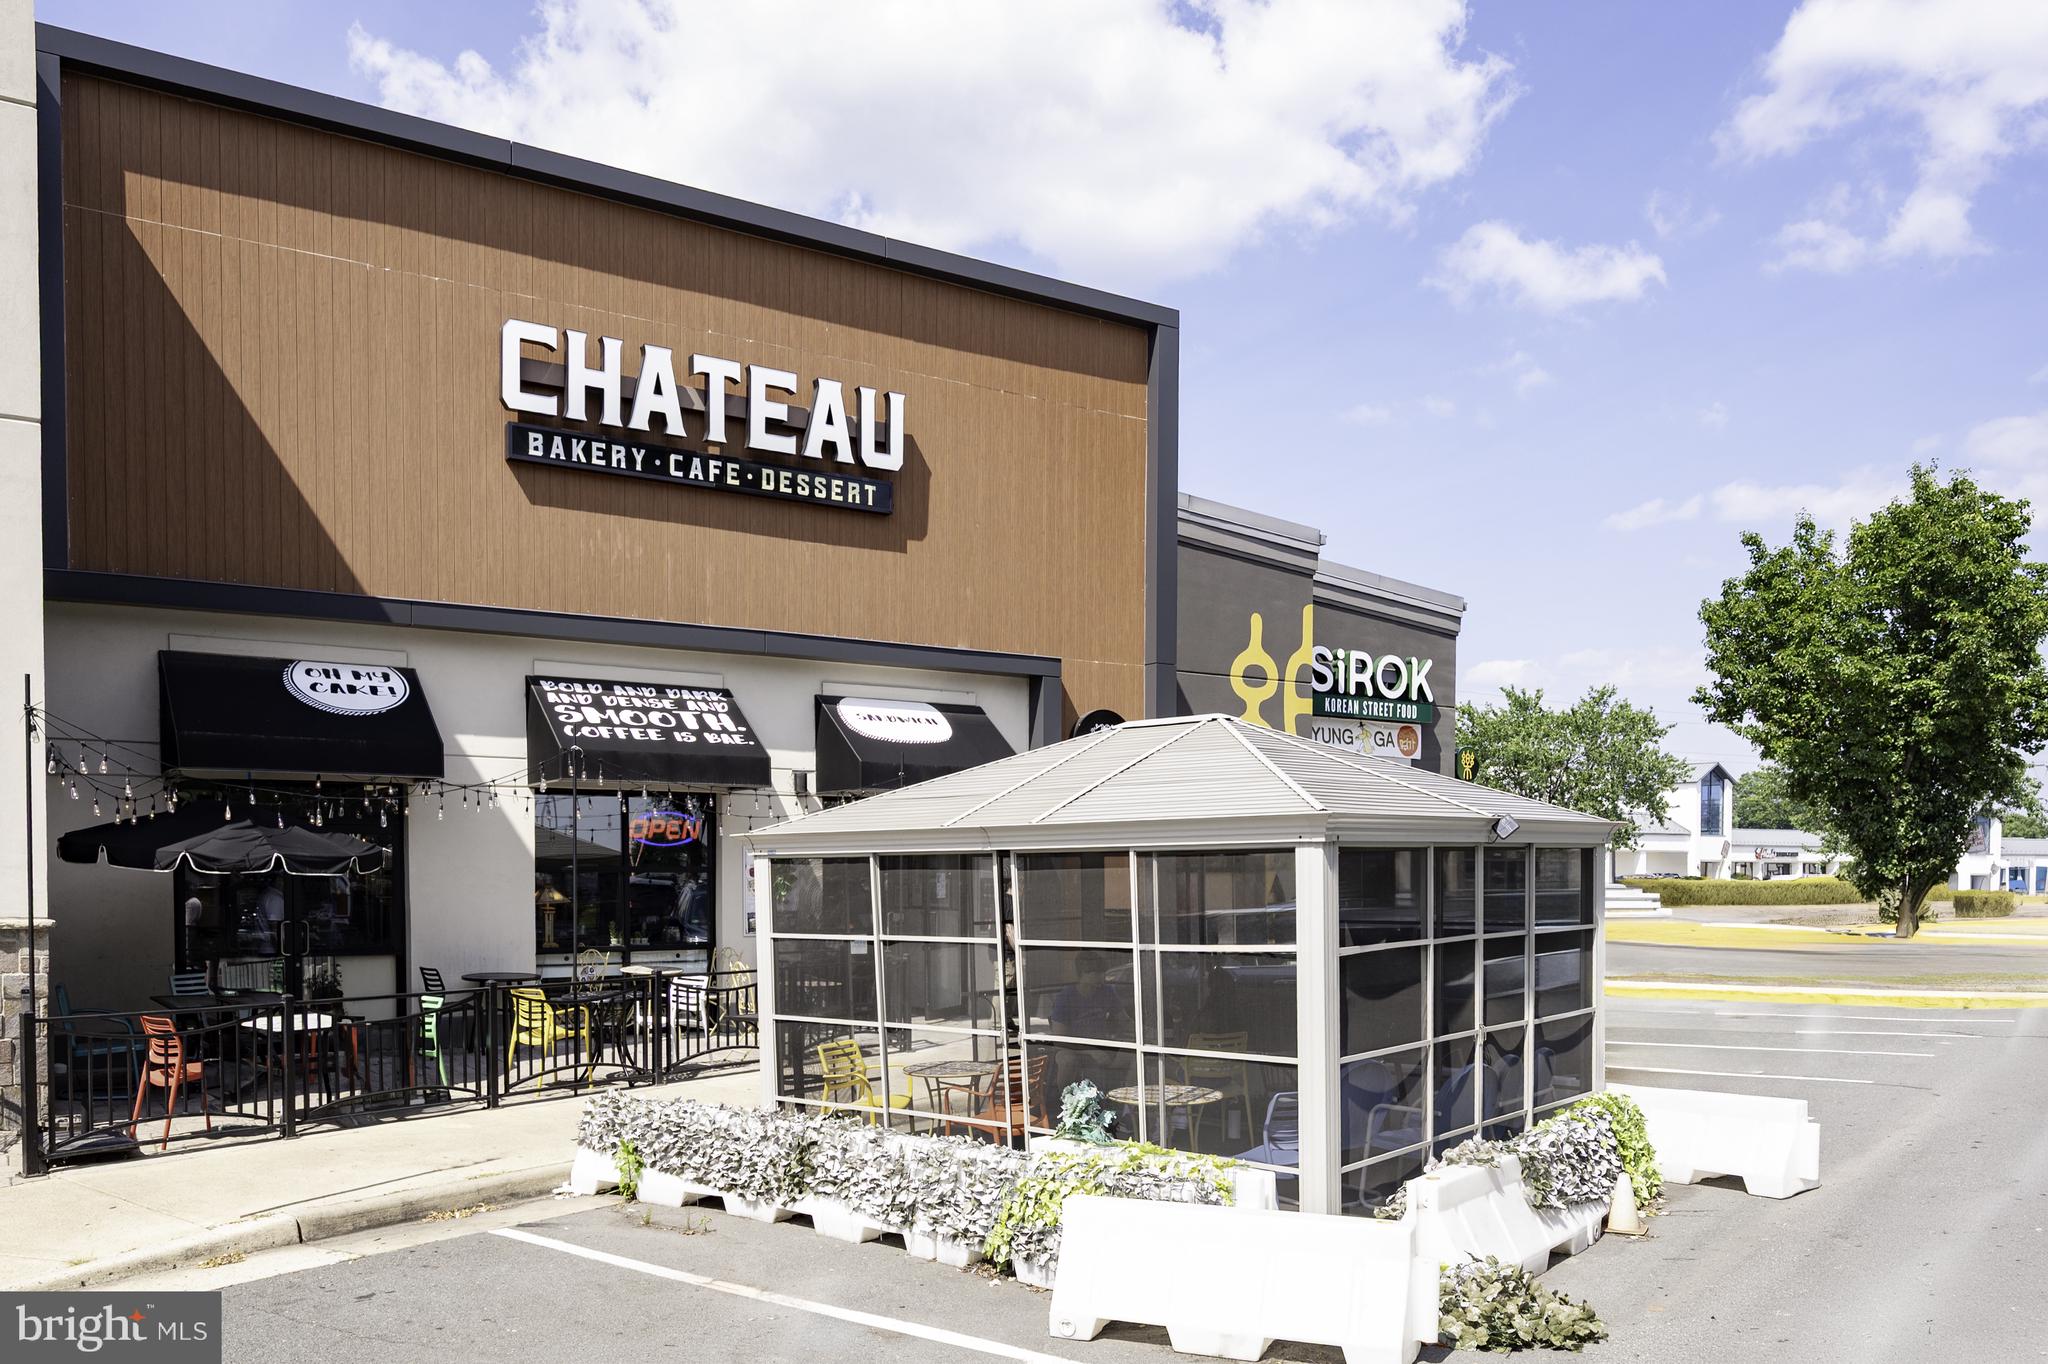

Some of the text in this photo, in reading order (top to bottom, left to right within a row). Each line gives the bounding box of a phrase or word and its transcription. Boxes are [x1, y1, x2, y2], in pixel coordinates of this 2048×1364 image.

[501, 318, 906, 472] CHATEAU
[527, 431, 877, 506] BAKERY CAFE DESSERT
[304, 668, 391, 683] OH MY
[309, 681, 398, 698] CAKE!
[539, 680, 728, 702] BOLD AND DARK
[546, 692, 729, 713] AND DENSE AND
[1324, 697, 1419, 720] KOREAN STREET FOOD
[554, 704, 747, 732] SMOOTH.
[563, 725, 755, 746] COFFEE IS BAE.
[1312, 726, 1354, 745] YUNG
[1373, 730, 1396, 748] GA
[629, 816, 701, 840] OPEN
